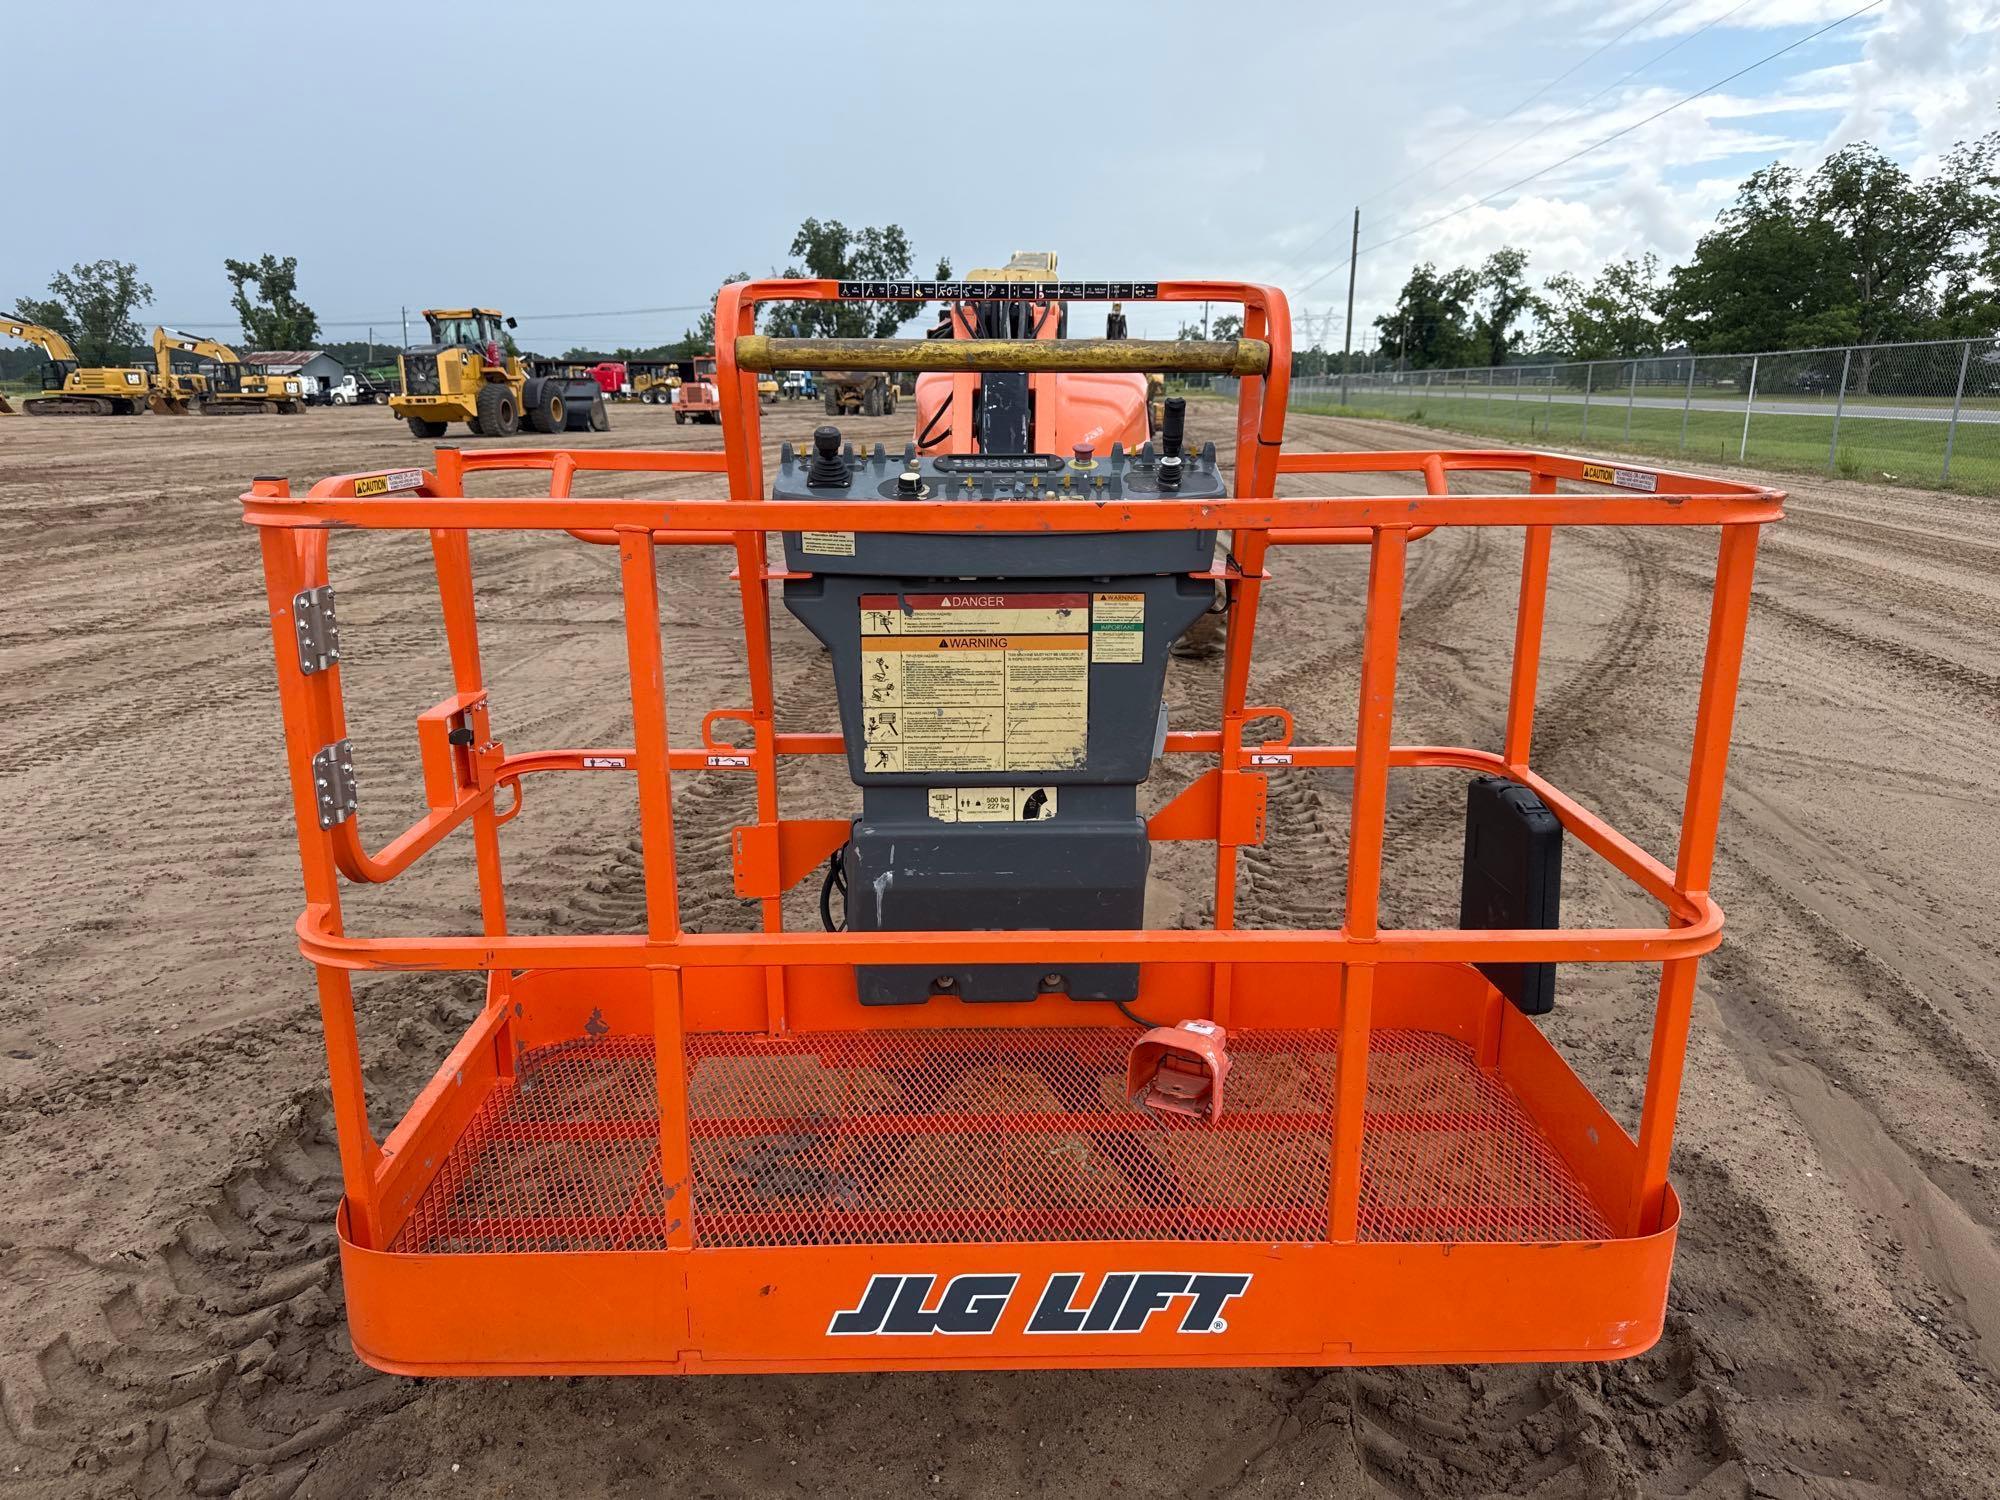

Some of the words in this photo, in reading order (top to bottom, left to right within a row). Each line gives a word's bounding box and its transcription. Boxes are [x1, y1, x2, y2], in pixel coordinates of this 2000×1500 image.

[286, 382, 298, 393] CAT
[1589, 467, 1613, 482] CAUTION
[362, 478, 387, 493] CAUTION
[952, 596, 1005, 607] DANGER
[950, 637, 1008, 648] WARNING
[1001, 803, 1009, 811] kg
[825, 1273, 1021, 1336] JLG
[1023, 1271, 1254, 1335] LIFT
